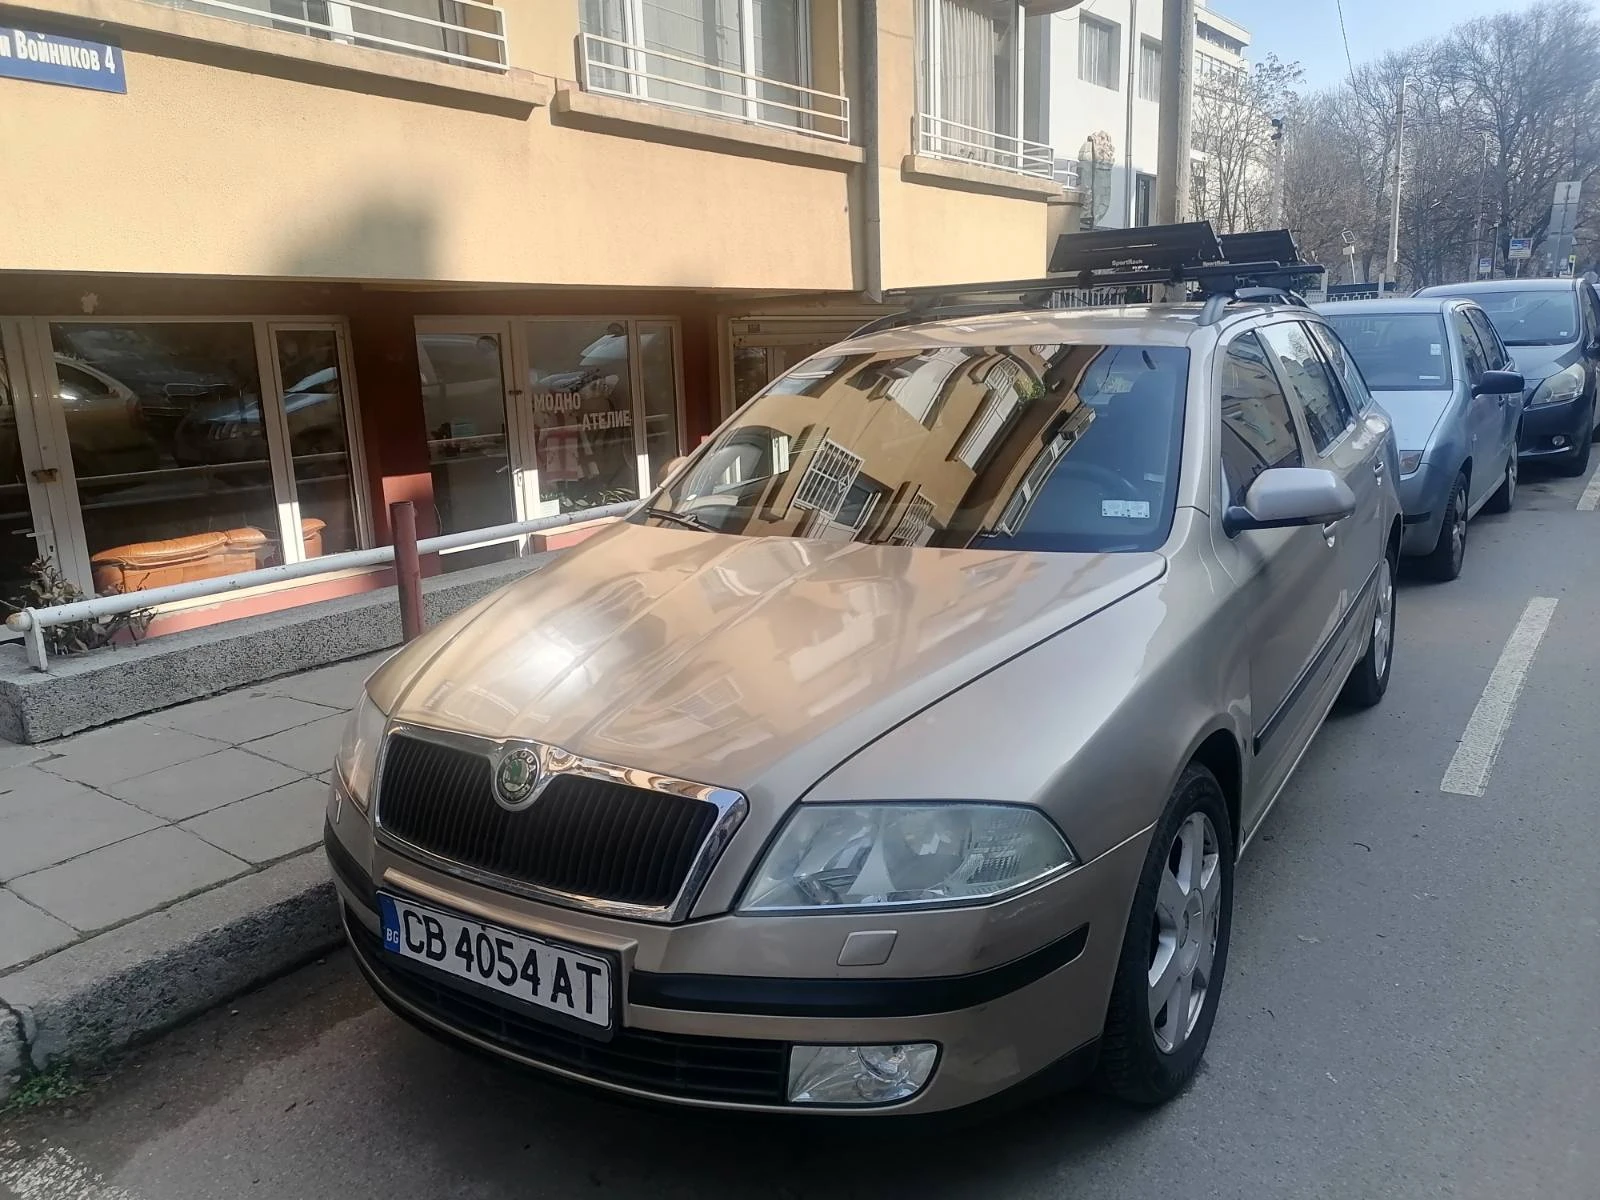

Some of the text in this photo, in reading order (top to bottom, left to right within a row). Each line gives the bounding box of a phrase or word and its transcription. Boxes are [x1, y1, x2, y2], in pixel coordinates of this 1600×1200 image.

[14, 29, 100, 71] Войников
[105, 45, 115, 74] 4
[533, 391, 581, 414] МОДНО
[582, 410, 632, 431] АТЕЛИЕ
[386, 928, 399, 944] BG
[403, 910, 602, 1015] CB 4054 AT
